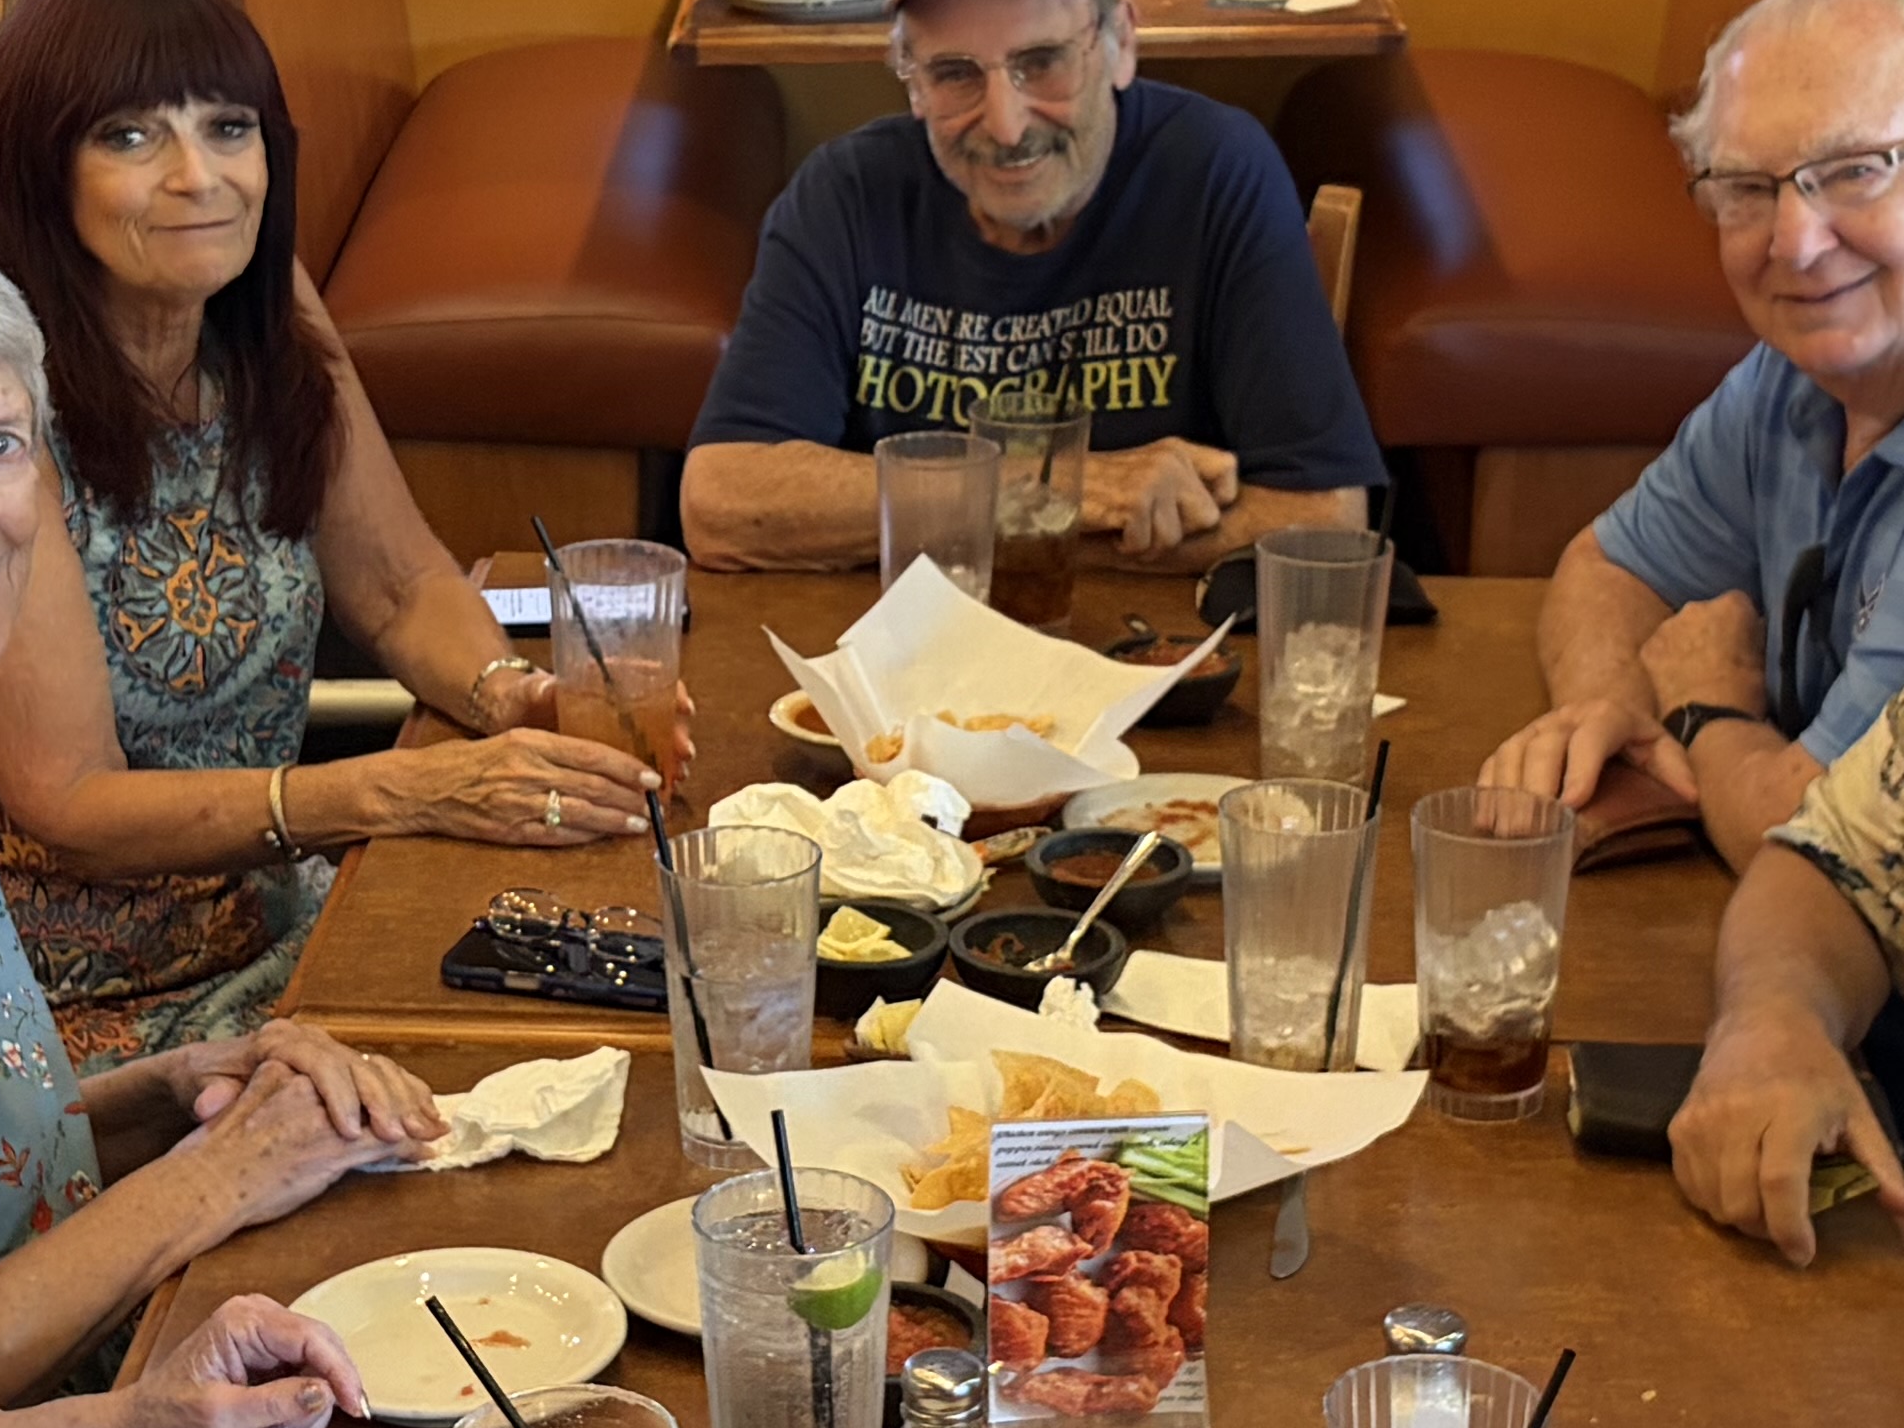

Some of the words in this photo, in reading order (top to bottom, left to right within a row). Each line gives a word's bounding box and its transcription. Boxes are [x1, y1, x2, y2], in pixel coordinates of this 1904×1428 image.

[862, 285, 897, 320] ALL
[899, 297, 953, 335] MEN
[954, 312, 991, 342] RE
[992, 298, 1093, 342] CREATD
[1094, 287, 1173, 327] EQUAL
[860, 317, 902, 354] BUT
[903, 330, 952, 367] THE
[953, 345, 1004, 374] EST
[1126, 322, 1169, 353] DO
